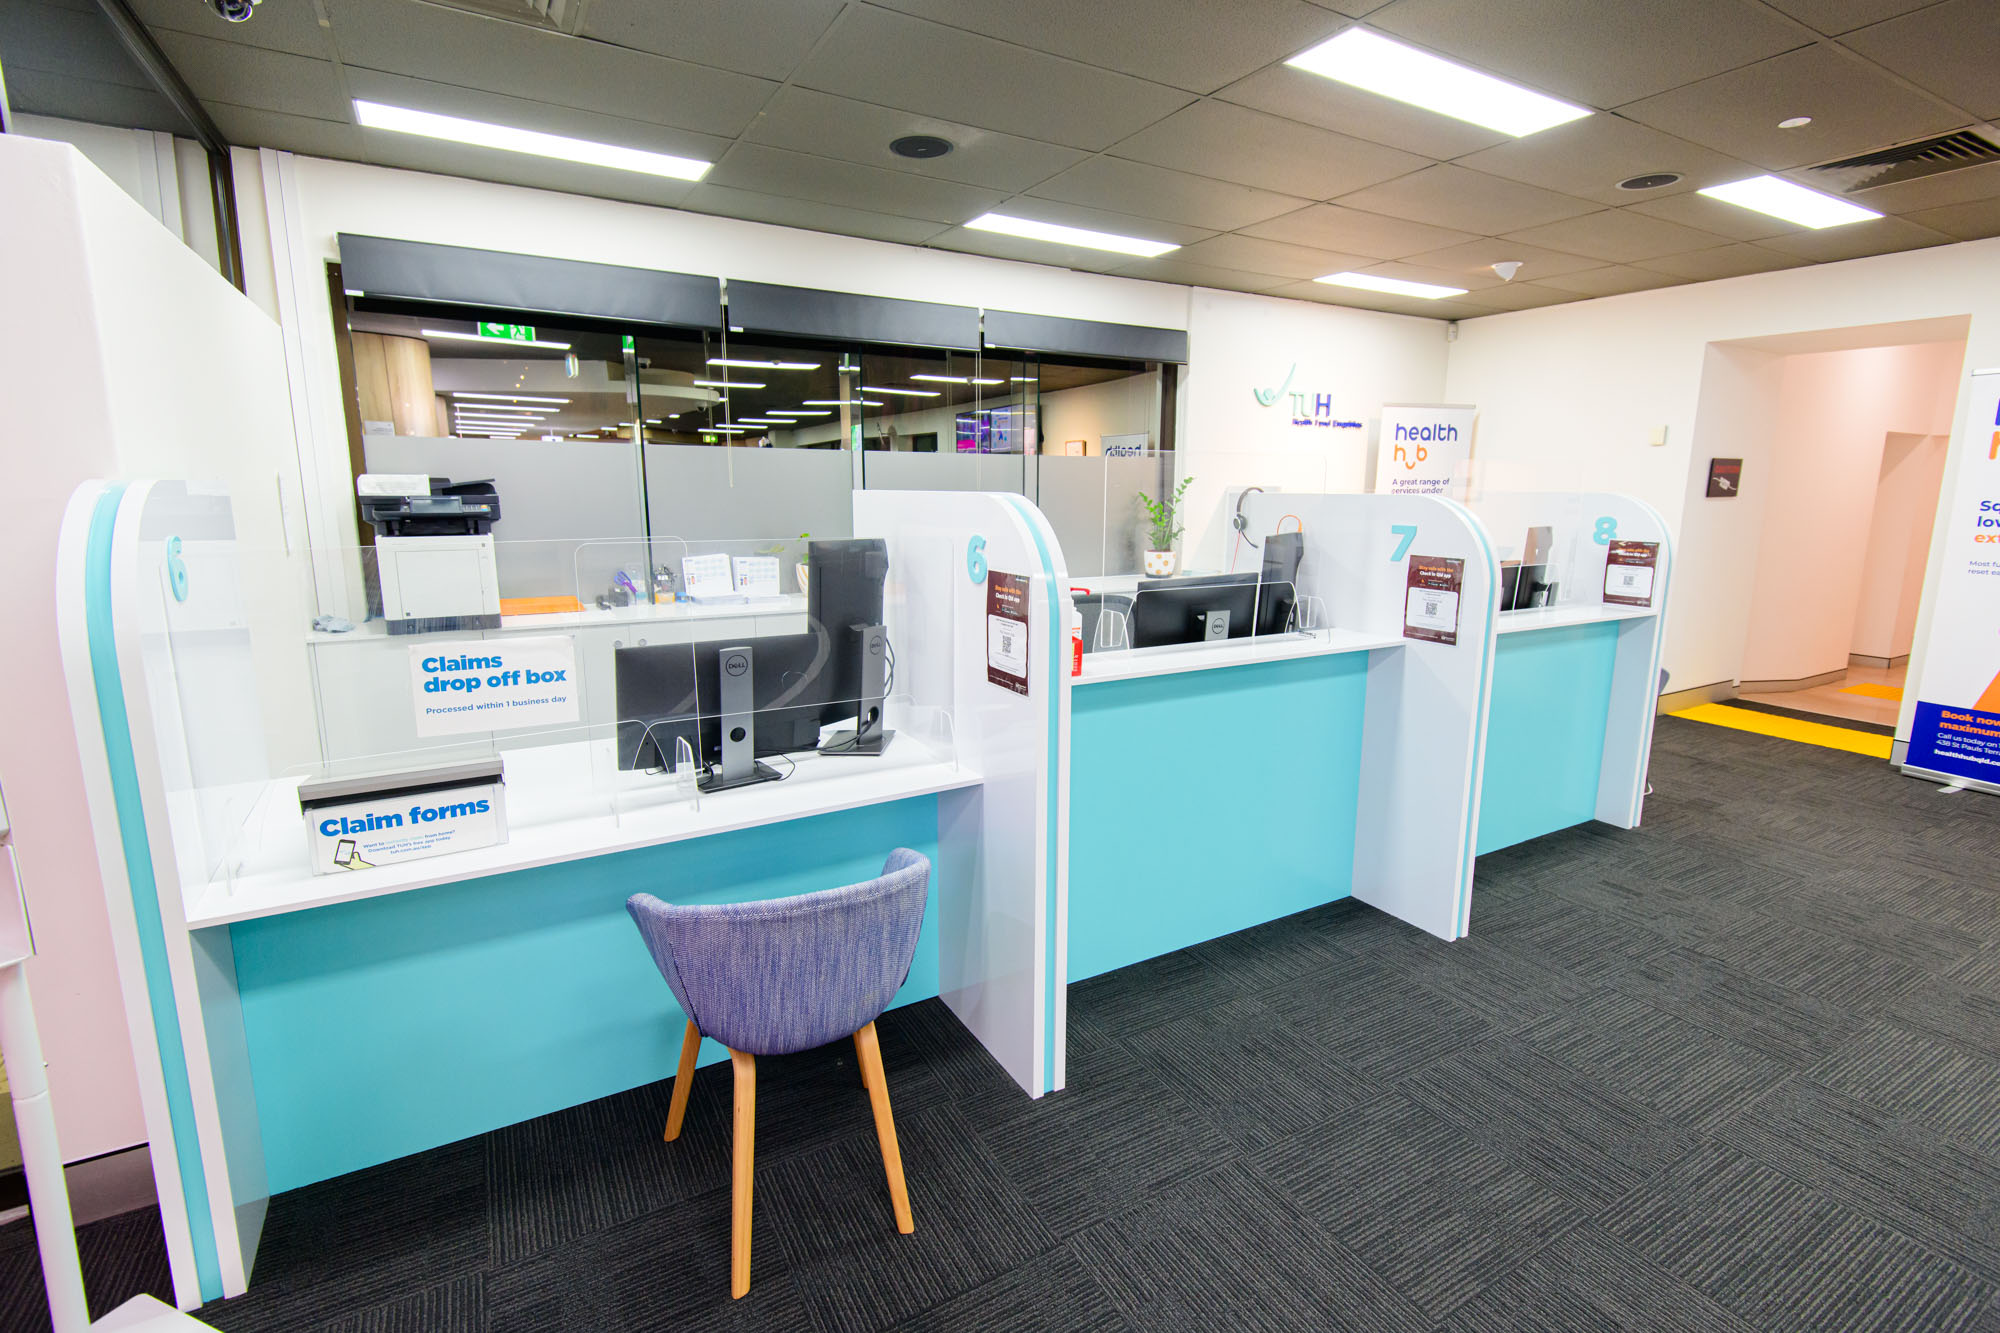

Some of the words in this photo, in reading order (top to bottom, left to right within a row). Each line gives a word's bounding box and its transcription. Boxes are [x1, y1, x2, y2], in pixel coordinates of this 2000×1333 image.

[1289, 392, 1332, 417] TUH
[1395, 423, 1458, 442] health
[1593, 516, 1617, 545] 8
[1390, 524, 1417, 562] 7
[167, 536, 188, 602] 6
[967, 535, 987, 584] 6
[422, 655, 503, 673] Claims
[424, 677, 481, 693] drop
[487, 670, 521, 687] off
[525, 669, 567, 684] box
[426, 704, 474, 714] Processed
[476, 701, 504, 710] within
[512, 697, 549, 706] business
[1941, 710, 1974, 722] Book
[1961, 744, 1982, 752] Pauls
[1963, 738, 1986, 746] today
[319, 813, 404, 837] Claim
[409, 800, 490, 825] forms
